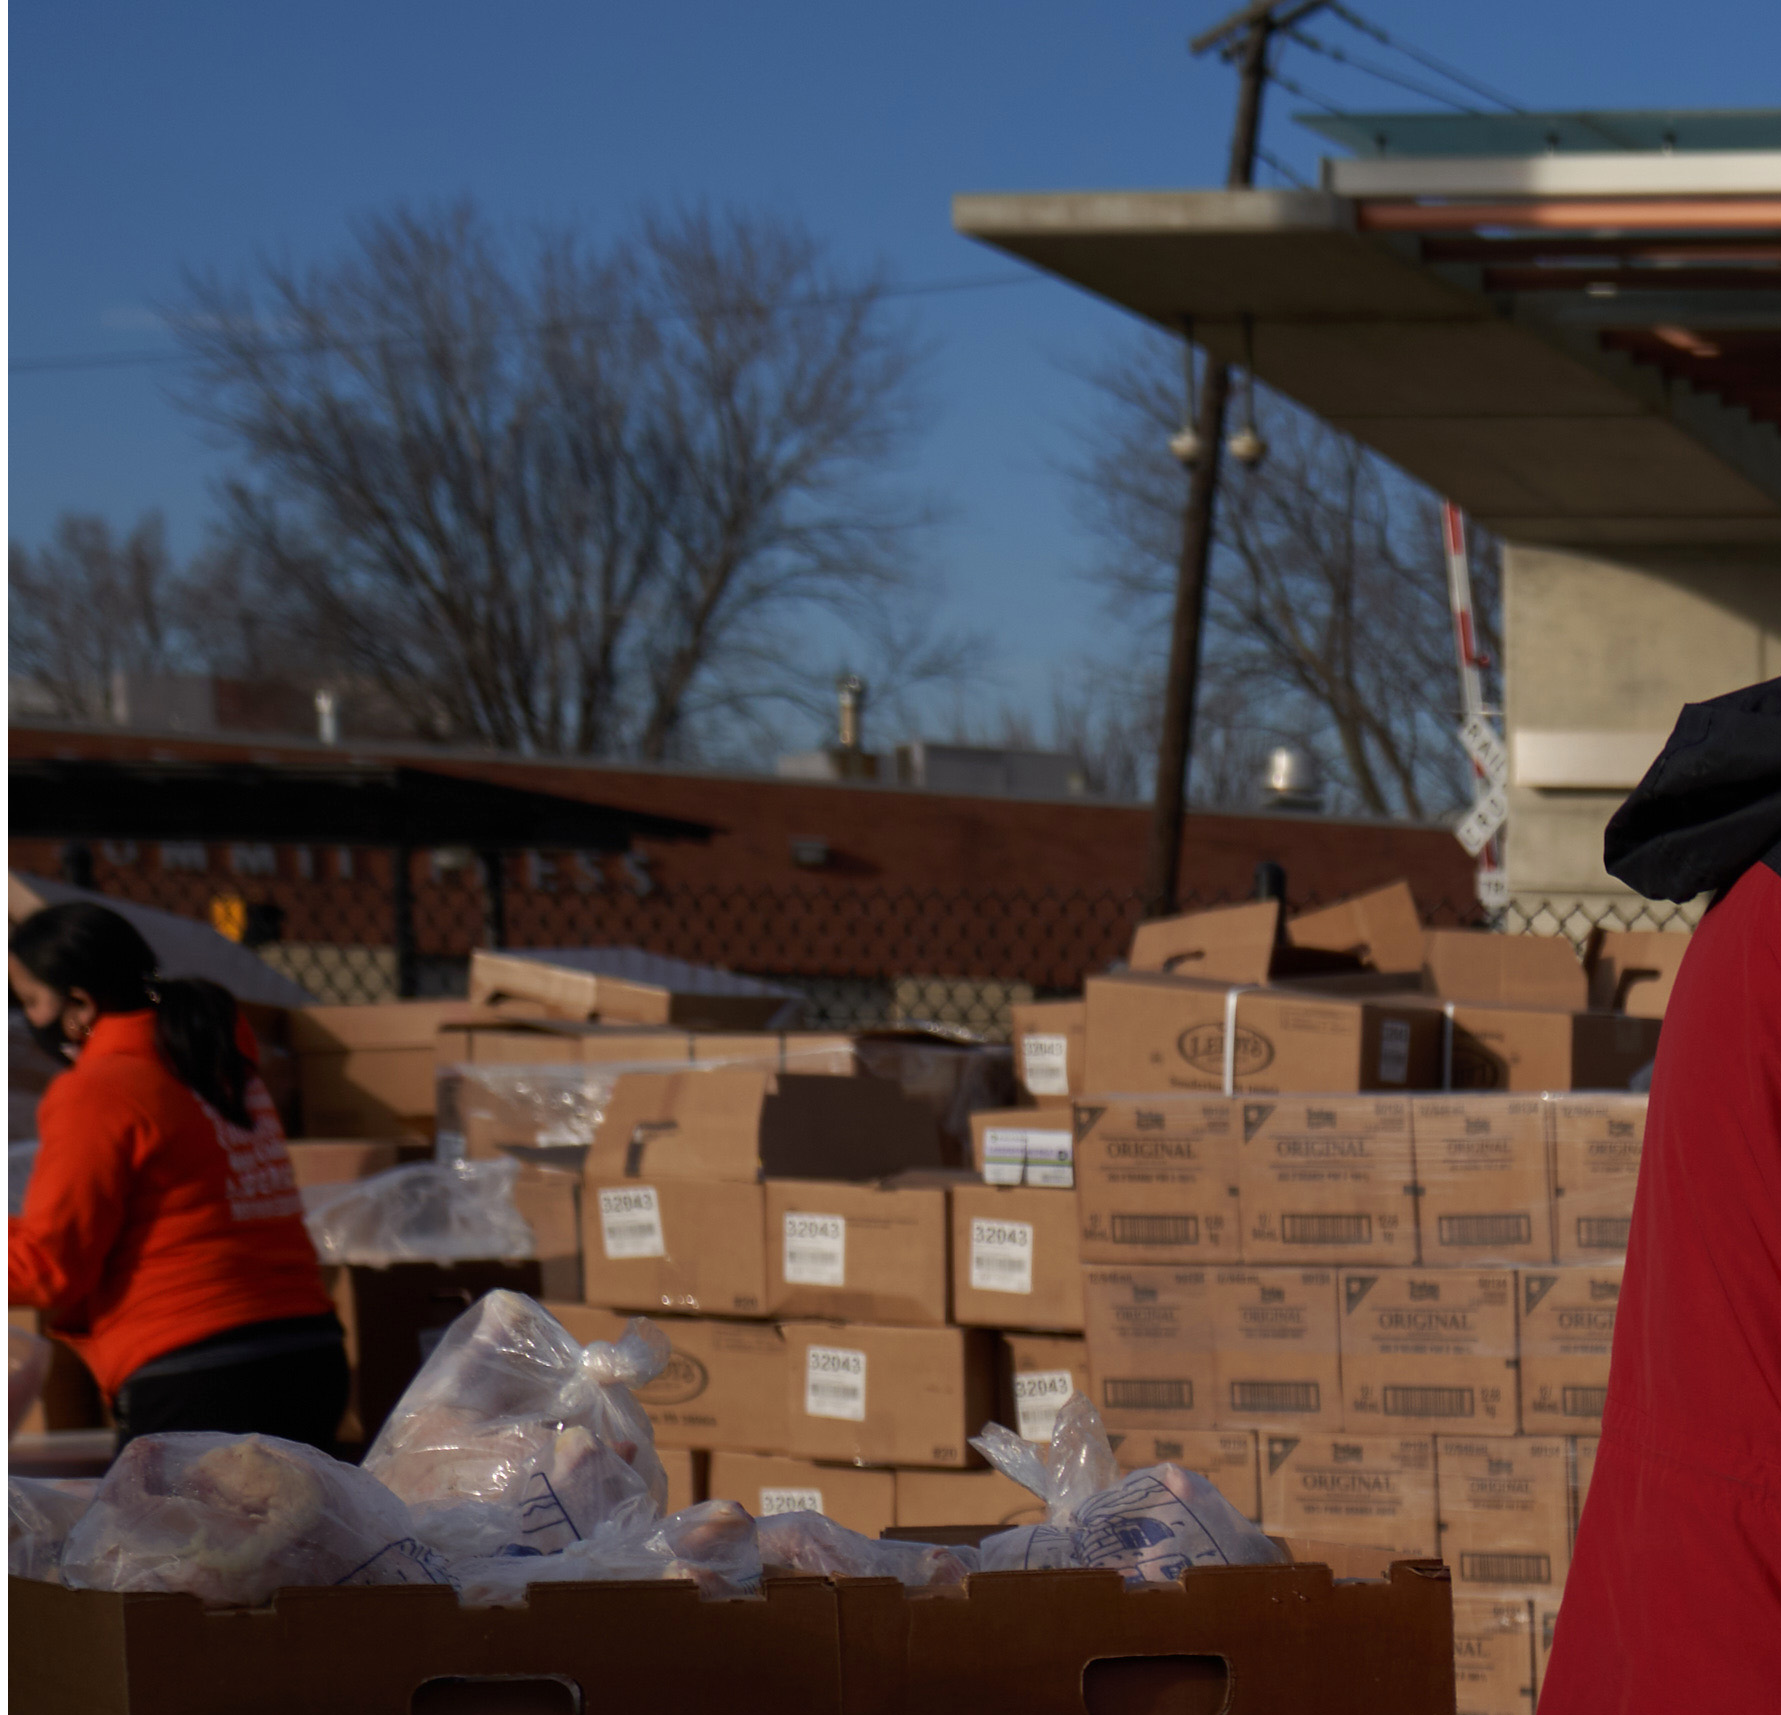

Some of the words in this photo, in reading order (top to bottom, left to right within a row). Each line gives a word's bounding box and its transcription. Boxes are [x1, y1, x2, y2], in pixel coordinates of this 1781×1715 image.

[603, 1195, 654, 1214] 32043
[786, 1221, 840, 1239] 32043
[975, 1226, 1028, 1247] 32043
[810, 1354, 861, 1373] 32043
[1017, 1377, 1068, 1398] 32043
